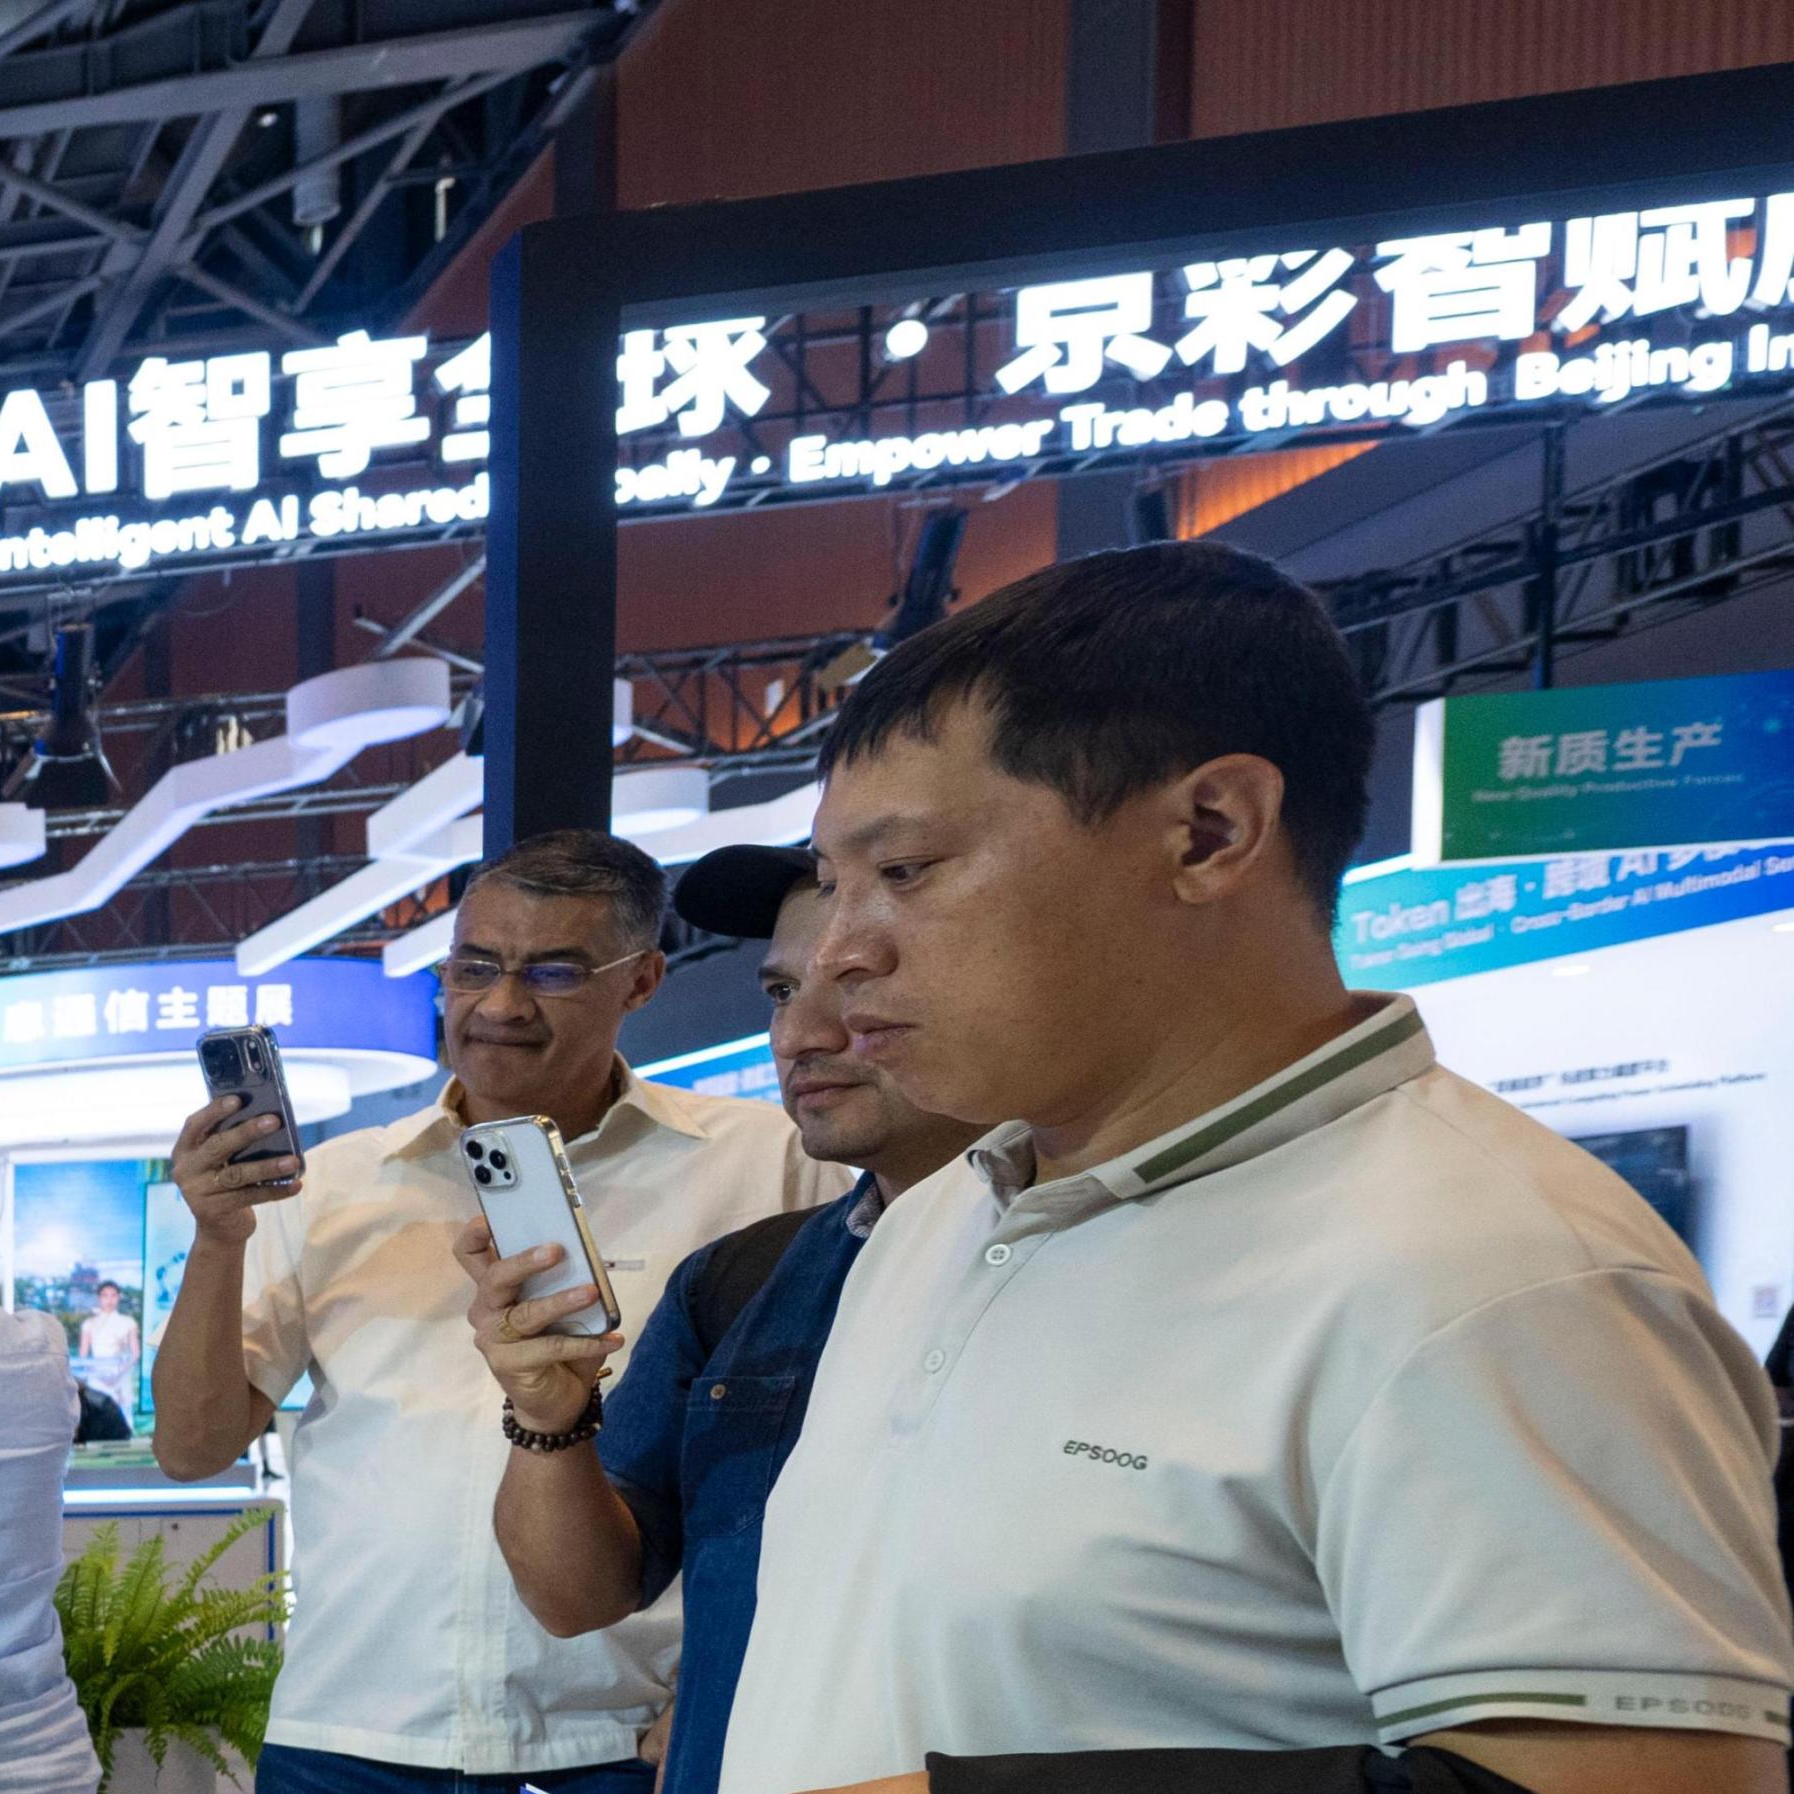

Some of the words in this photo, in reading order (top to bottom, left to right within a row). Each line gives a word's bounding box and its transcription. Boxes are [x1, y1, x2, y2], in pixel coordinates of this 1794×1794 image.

[995, 192, 1794, 396] 京彩智赋
[242, 495, 299, 545] AI
[309, 472, 490, 537] Shared
[790, 420, 1054, 486] Empower
[1060, 392, 1230, 451] Trade
[1238, 360, 1488, 427] through
[1515, 339, 1733, 403] Beijing
[1499, 721, 1723, 780] 新质生产
[1063, 1440, 1148, 1470] EPSOOG
